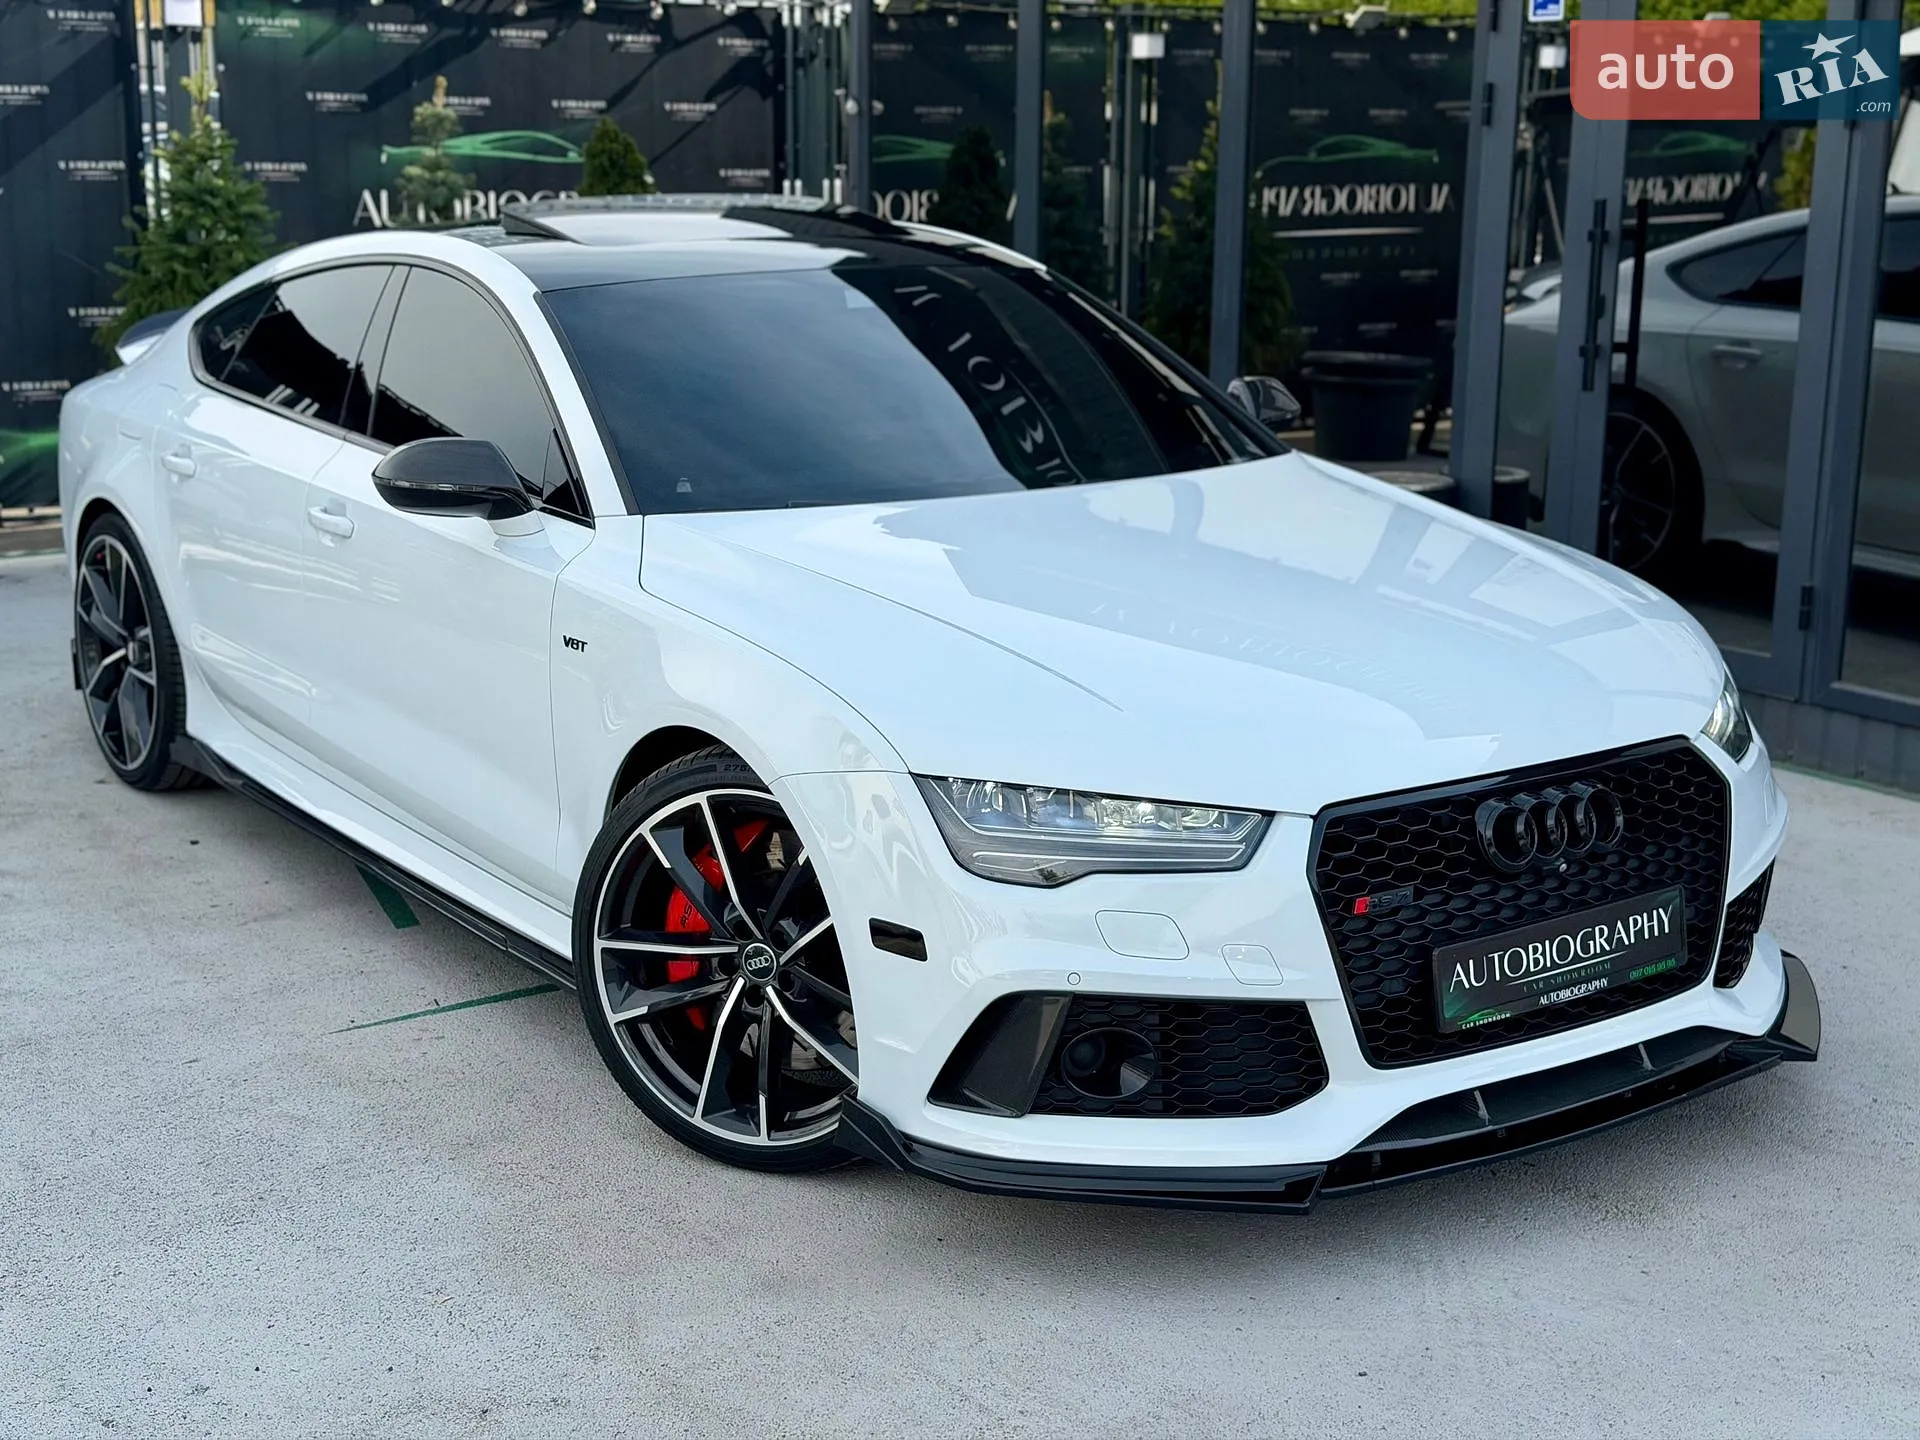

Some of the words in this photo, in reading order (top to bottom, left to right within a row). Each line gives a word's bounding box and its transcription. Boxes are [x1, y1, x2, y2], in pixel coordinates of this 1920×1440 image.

[563, 634, 588, 652] V8T
[1450, 904, 1672, 992] AUTOBIOGRAPHY
[1538, 977, 1608, 1006] AUTOBIOGRAPHY
